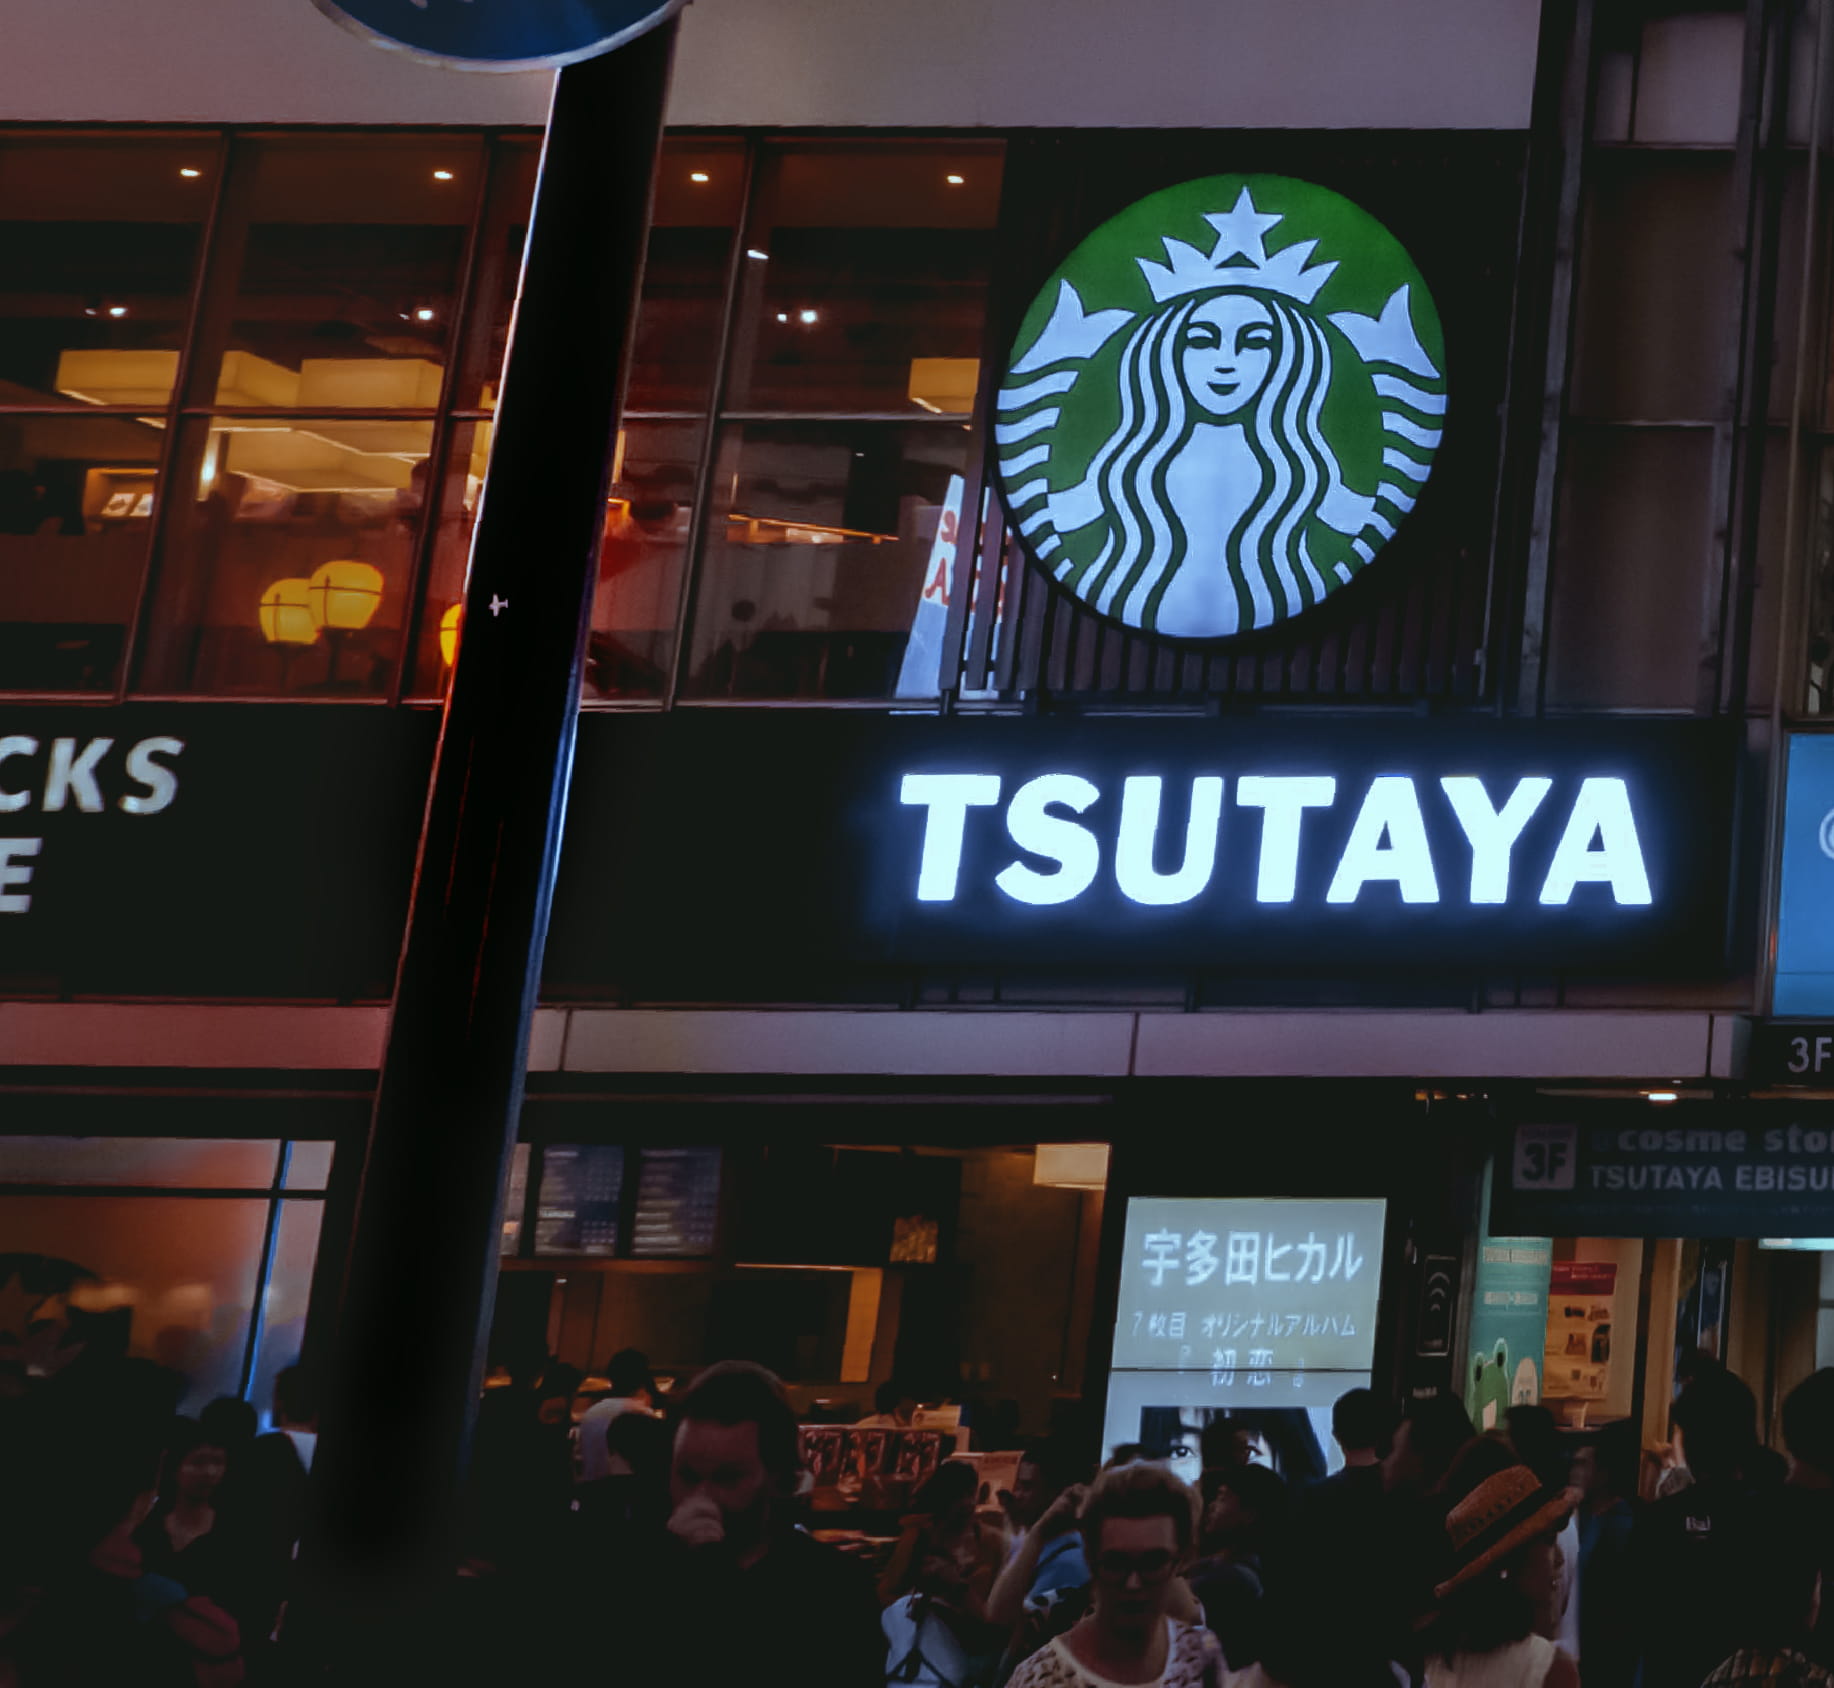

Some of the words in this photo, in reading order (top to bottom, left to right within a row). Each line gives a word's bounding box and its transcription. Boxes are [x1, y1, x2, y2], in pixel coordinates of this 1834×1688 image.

[901, 774, 1653, 905] TSUTAYA
[1787, 1036, 1833, 1074] 3F
[1522, 1144, 1567, 1182] 3F
[1591, 1165, 1723, 1192] TSUTAYA
[1142, 1228, 1363, 1287] 宇多田ヒカル
